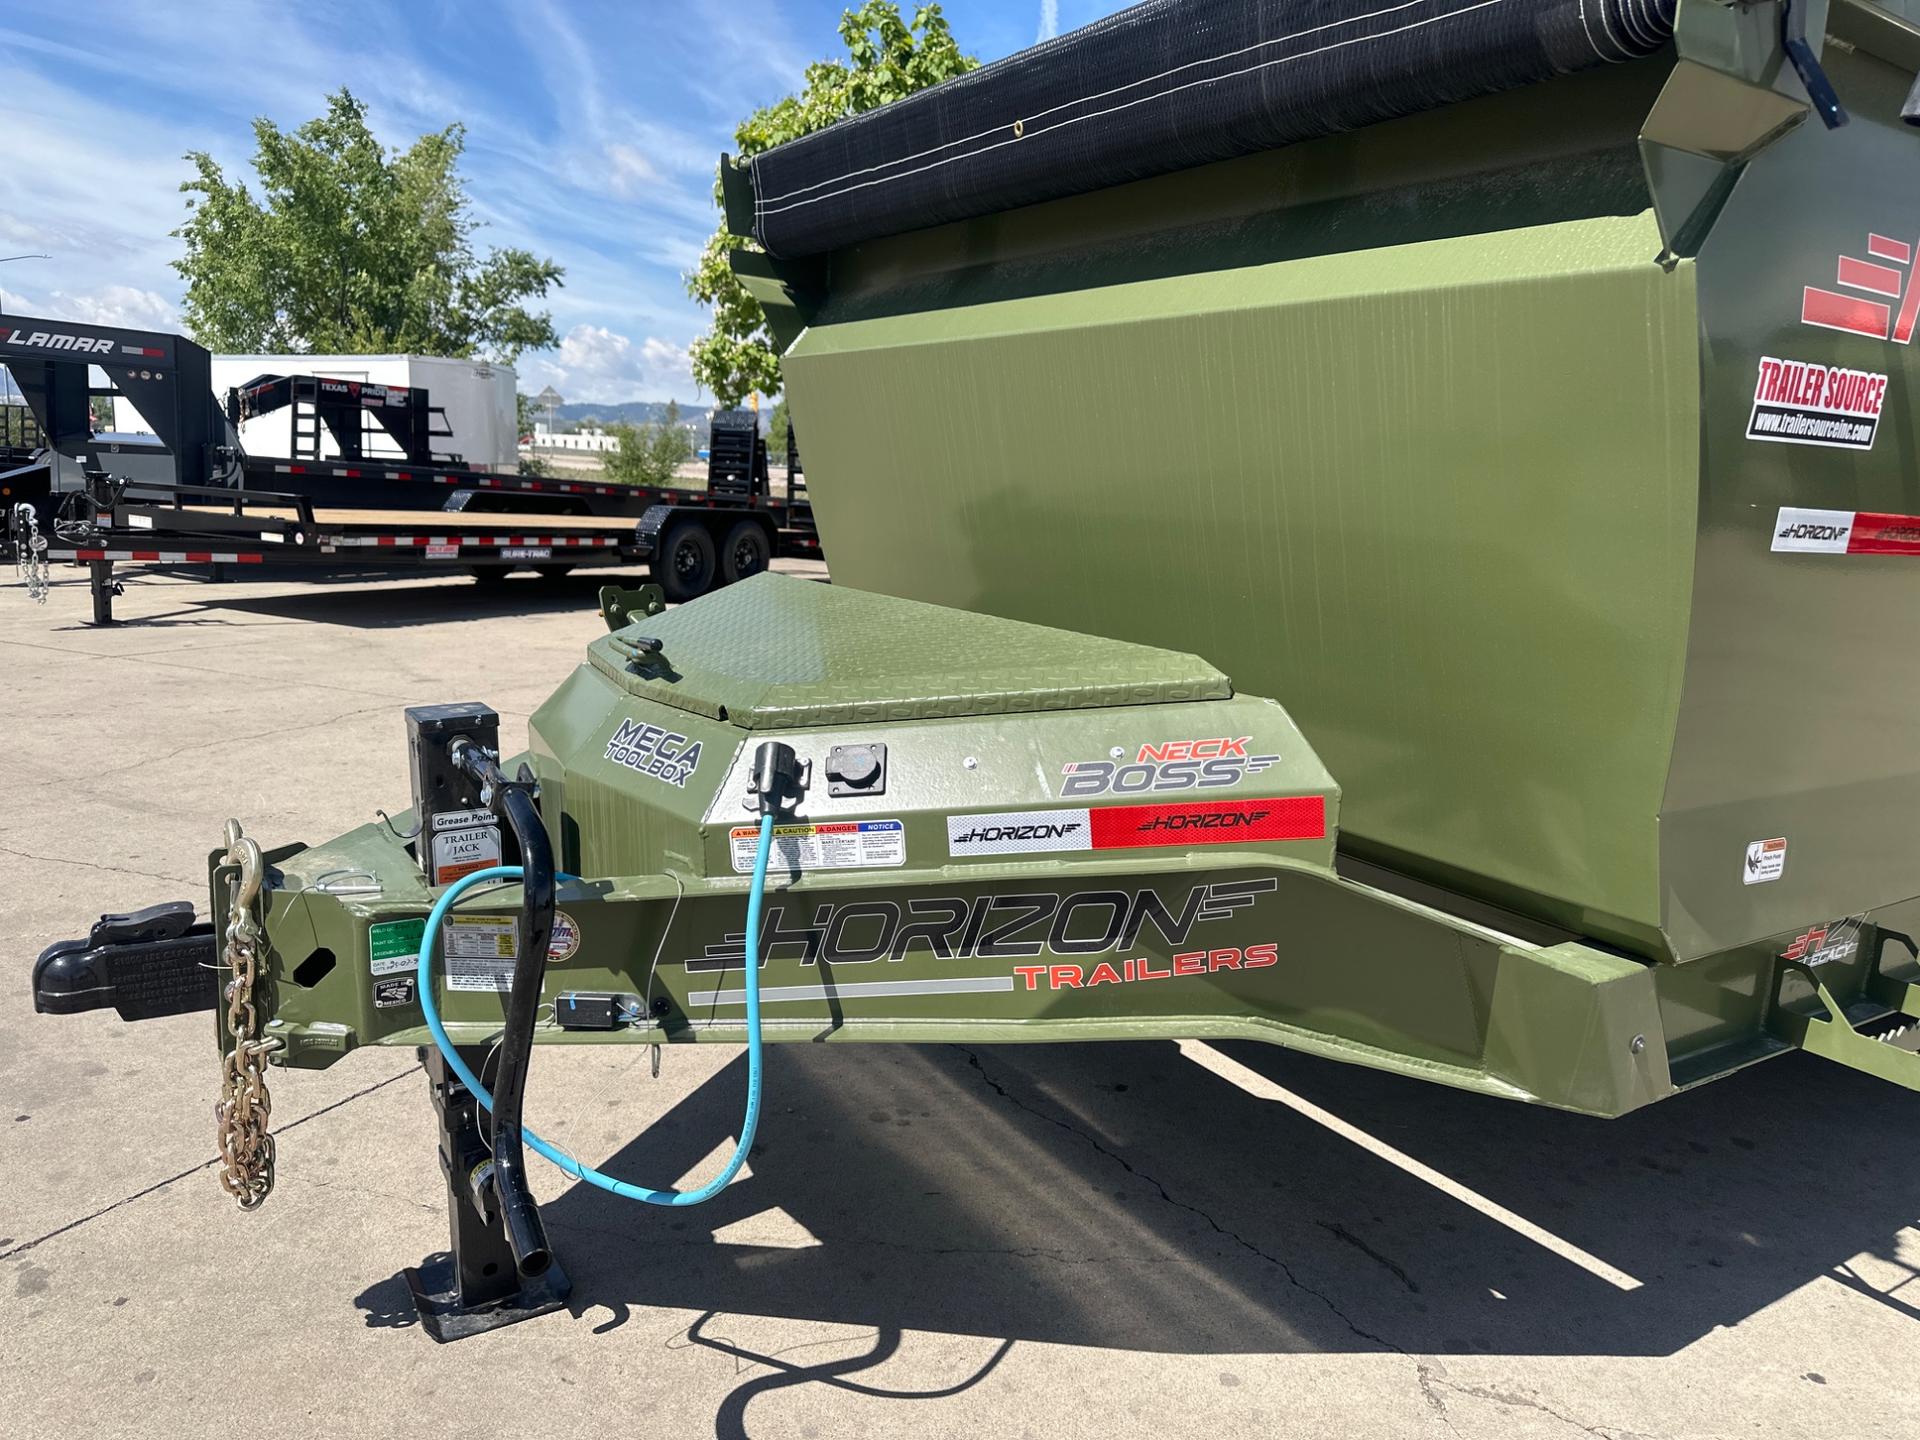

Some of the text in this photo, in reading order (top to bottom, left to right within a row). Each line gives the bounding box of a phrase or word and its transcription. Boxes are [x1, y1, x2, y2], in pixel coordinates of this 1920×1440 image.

[7, 330, 115, 354] LAMAR
[321, 383, 386, 397] TEXAS PRIDE
[1756, 361, 1886, 415] TRAILER SOURCE
[1754, 413, 1873, 442] www.trailersourceinc.com
[1785, 523, 1843, 541] HORIZON
[611, 717, 704, 771] MEGA
[1136, 735, 1254, 764] NECK
[604, 740, 695, 788] TOOLBOX
[1059, 756, 1248, 798] BOSS
[437, 813, 496, 826] Grease Point
[826, 825, 857, 833] DANGER
[1152, 812, 1258, 831] HORIZON
[443, 831, 488, 844] TRAILER
[966, 824, 1066, 843] HORIZON
[453, 843, 480, 855] JACK
[757, 884, 1210, 968] HORIZON
[1013, 943, 1280, 991] TRAILERS
[380, 980, 399, 990] MADE
